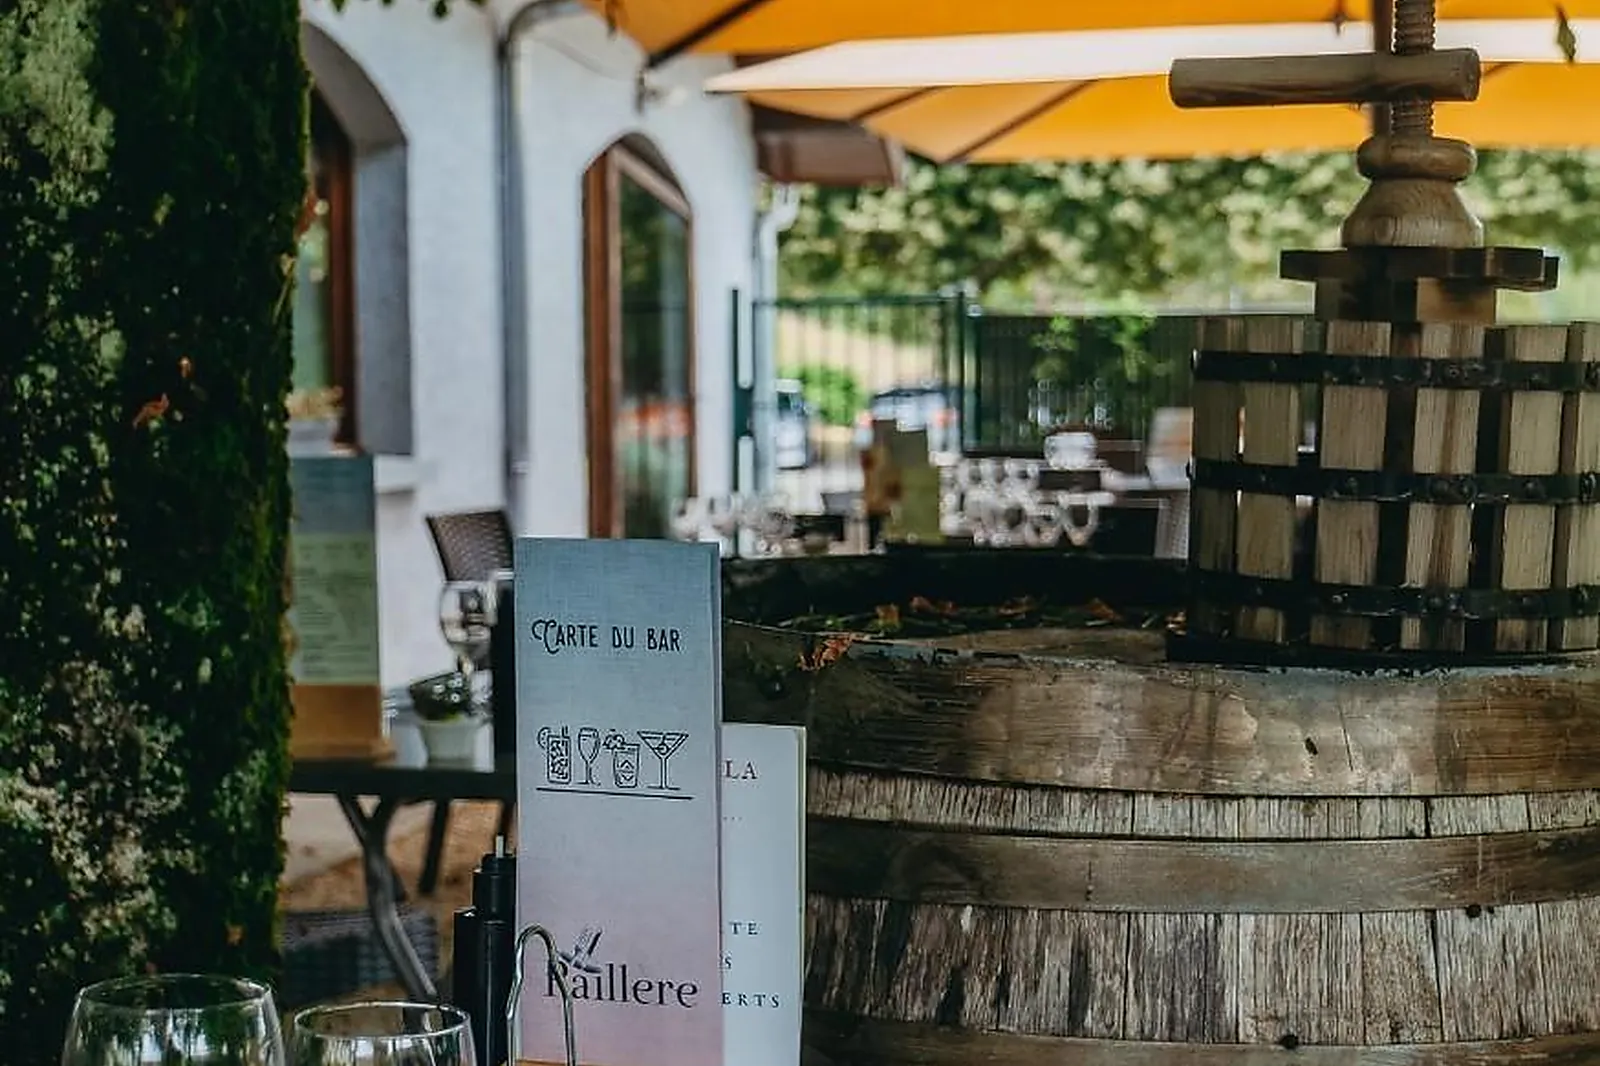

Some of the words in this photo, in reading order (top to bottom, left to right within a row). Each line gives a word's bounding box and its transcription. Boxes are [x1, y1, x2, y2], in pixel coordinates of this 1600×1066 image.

[532, 619, 598, 654] CARTE
[612, 626, 635, 649] DU
[647, 628, 680, 651] BAR
[725, 759, 757, 780] LA
